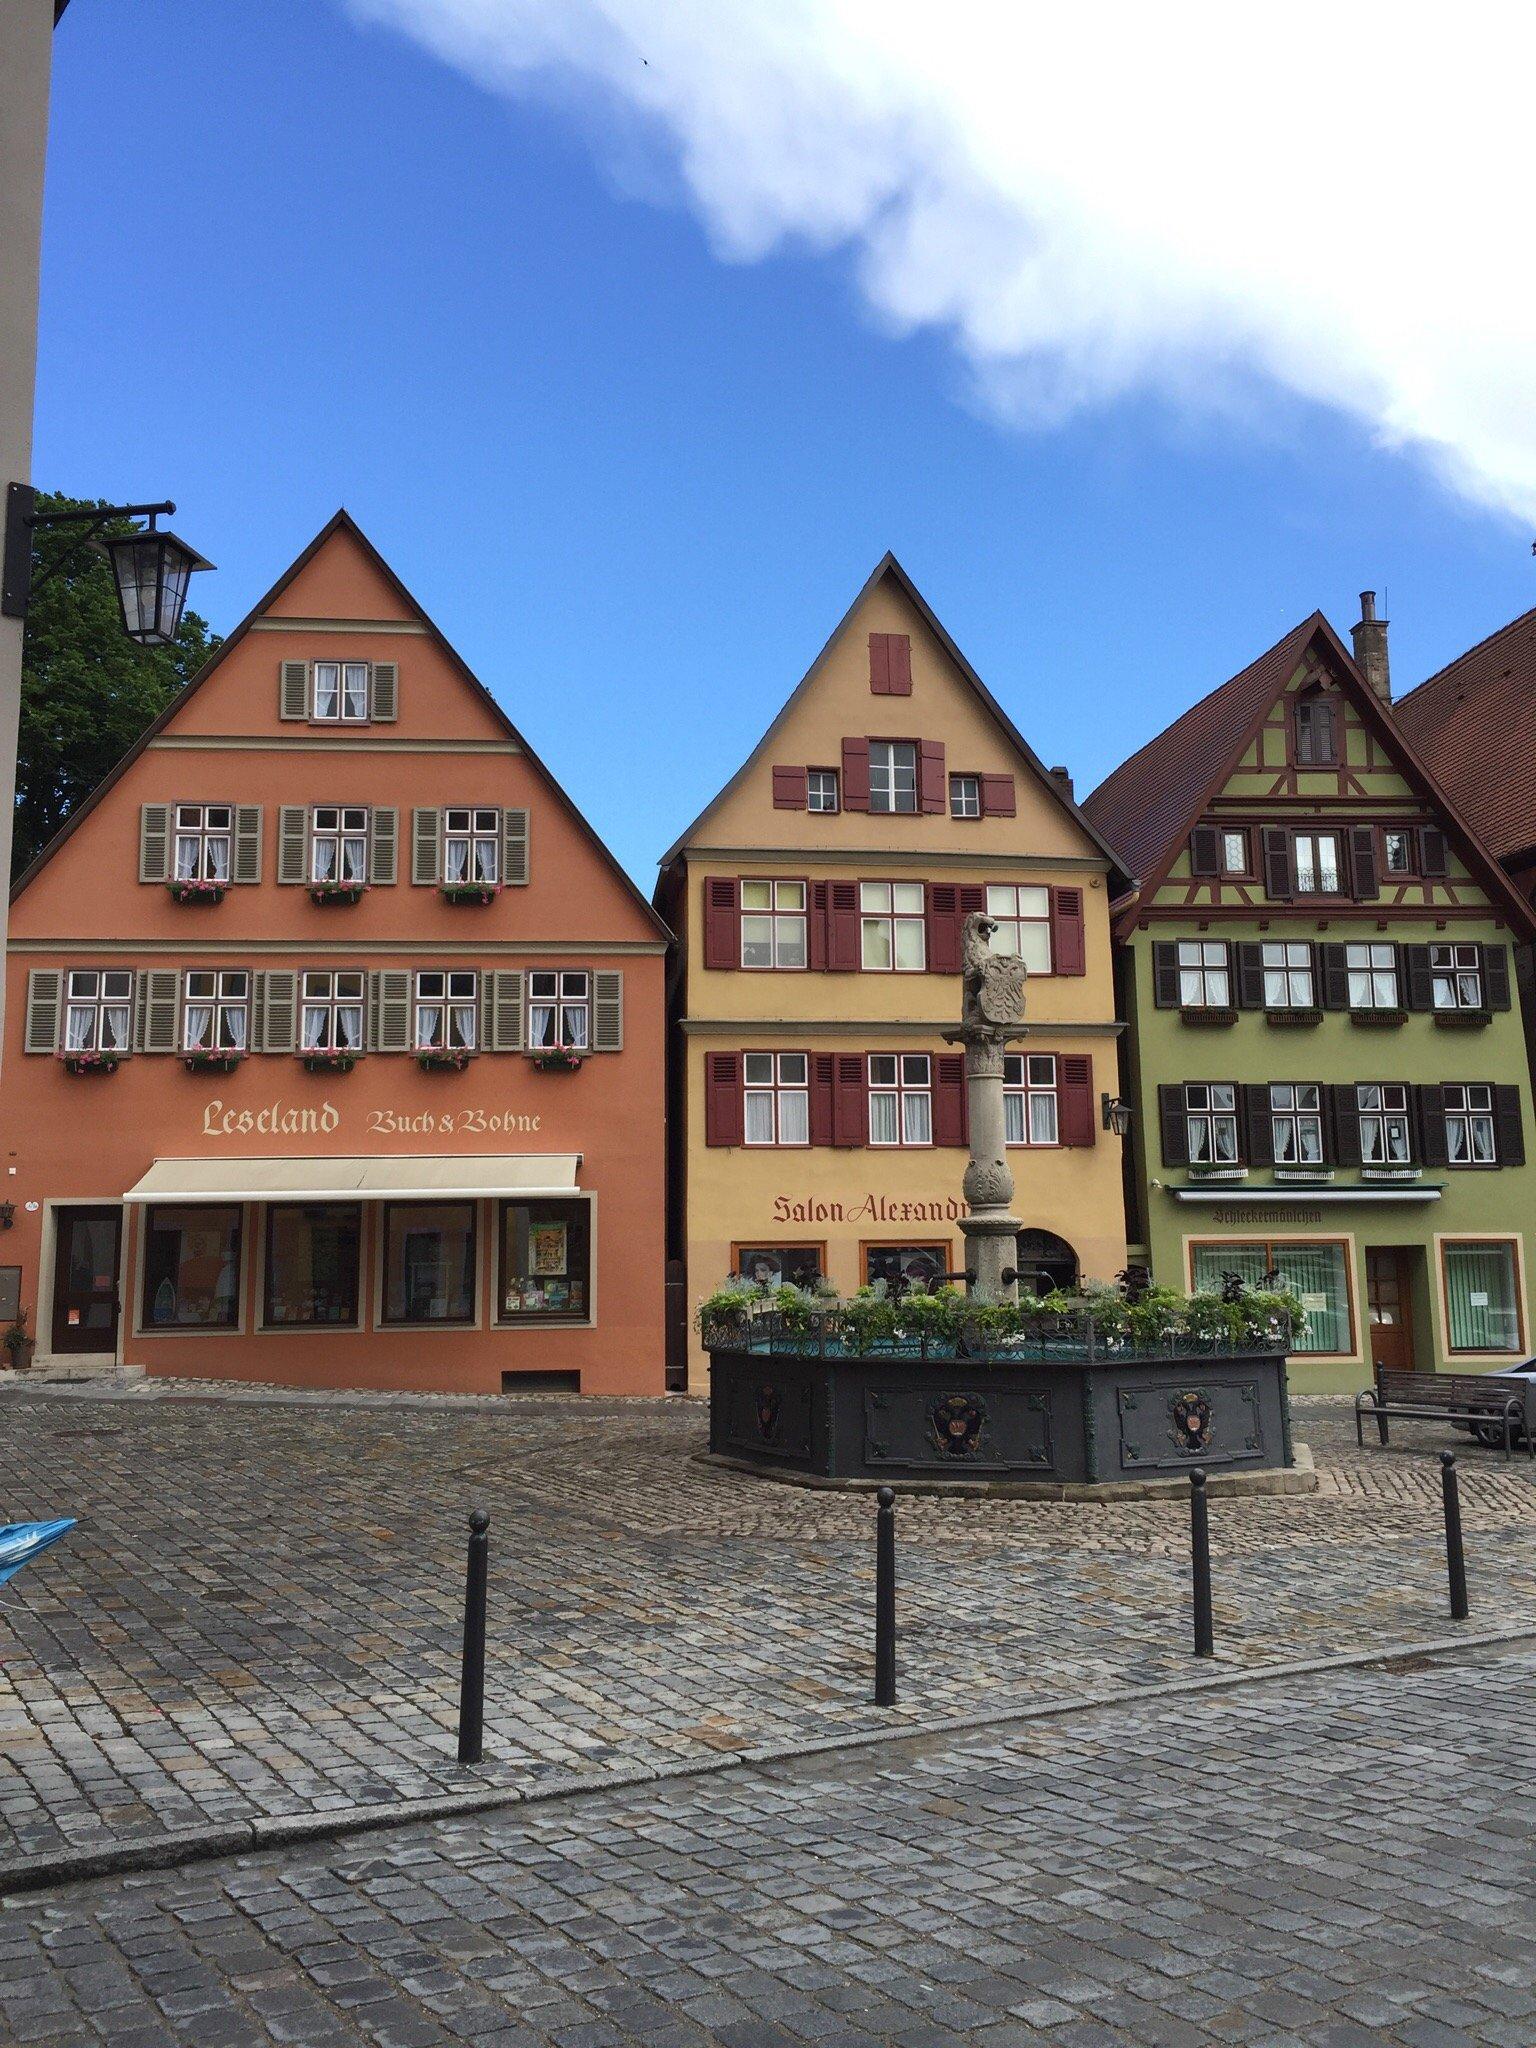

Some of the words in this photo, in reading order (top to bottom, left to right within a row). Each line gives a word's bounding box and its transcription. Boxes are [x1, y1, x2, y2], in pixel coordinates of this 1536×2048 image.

[202, 1099, 339, 1136] Leseland
[366, 1109, 435, 1136] Buch
[438, 1114, 455, 1135] &
[457, 1108, 542, 1136] Bohne
[771, 1194, 844, 1223] Salon
[847, 1193, 972, 1223] Alexandr
